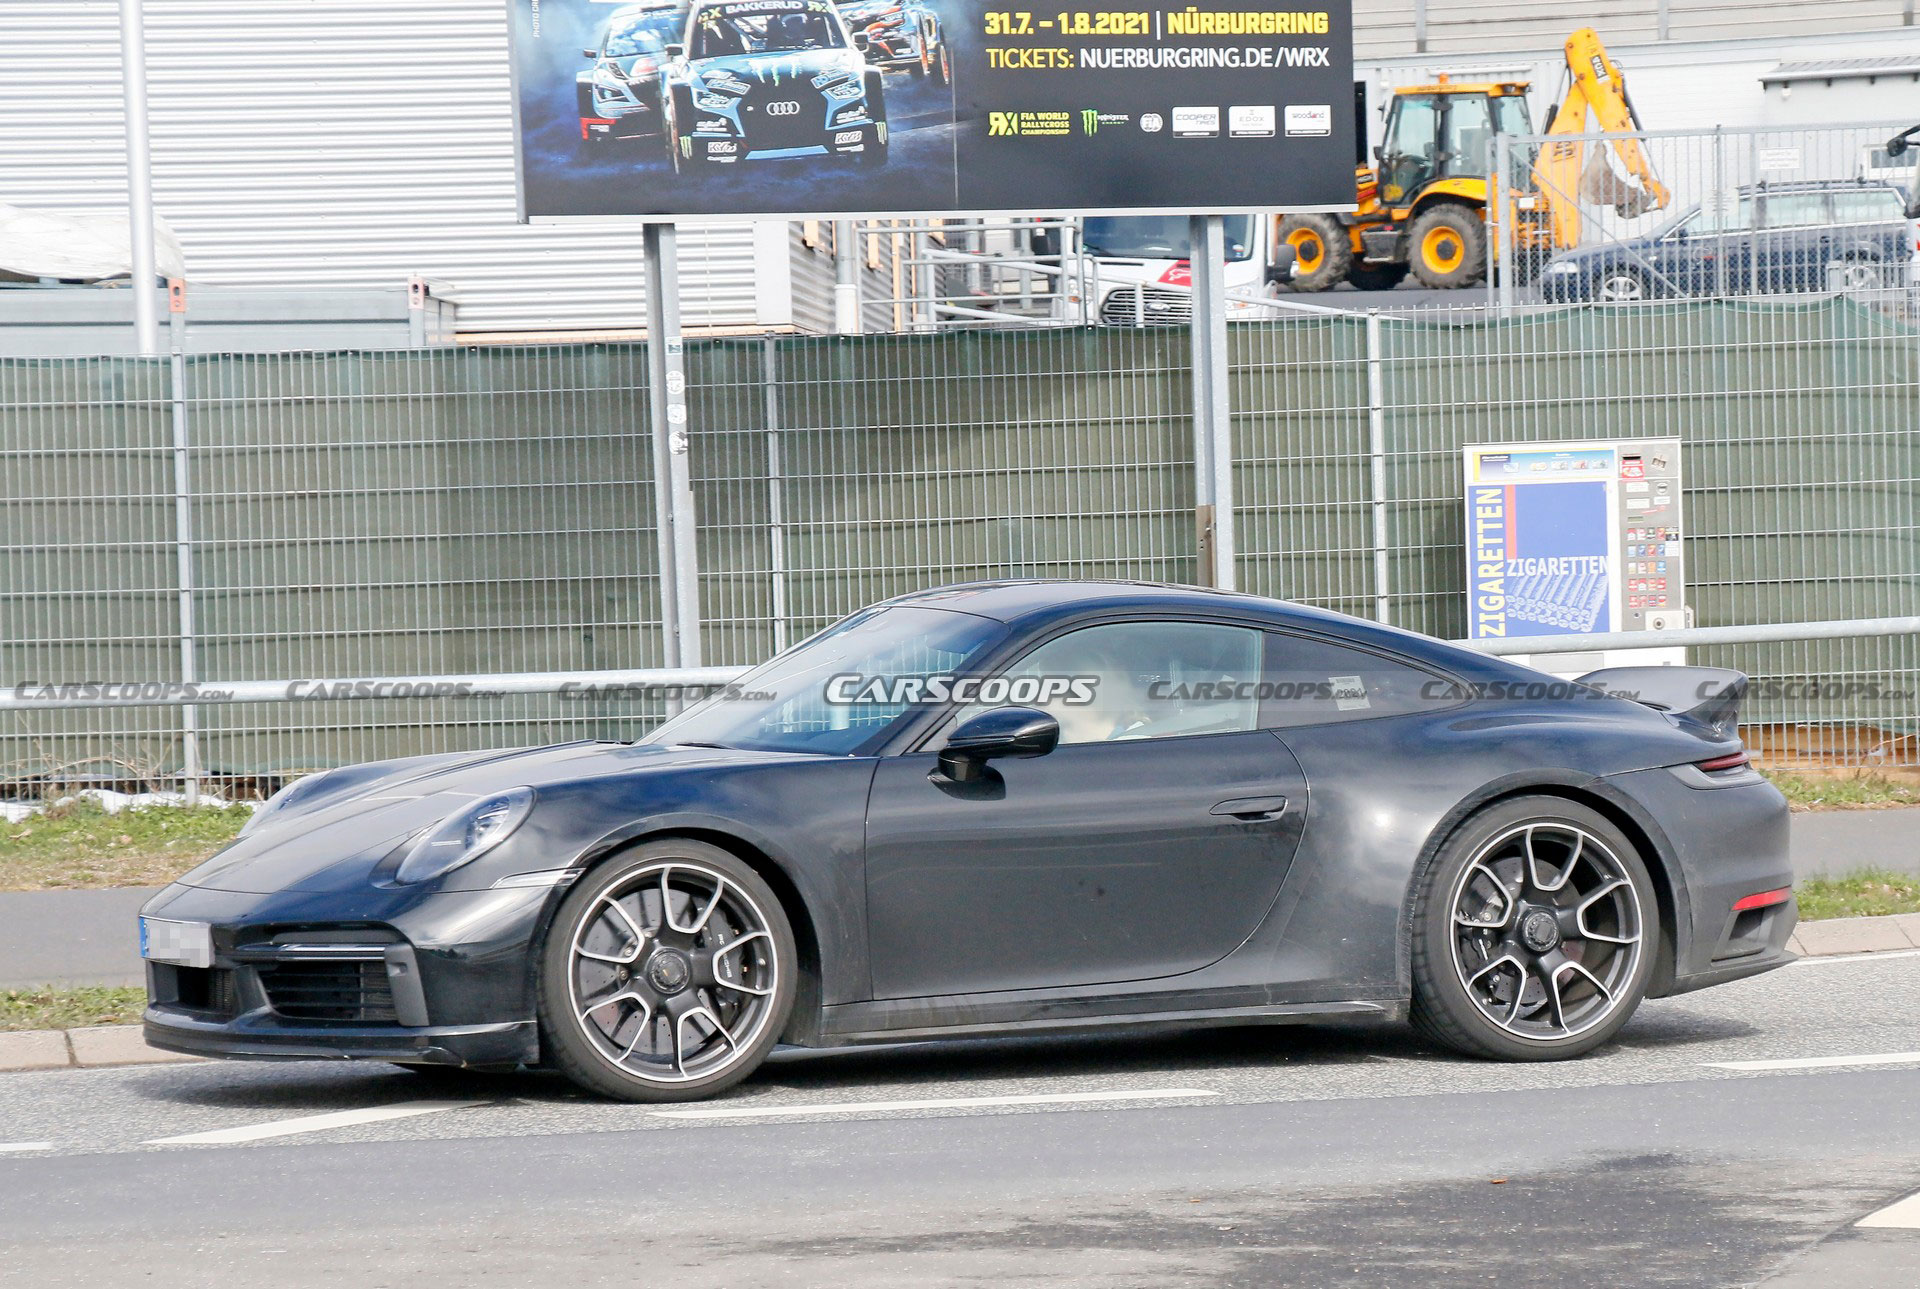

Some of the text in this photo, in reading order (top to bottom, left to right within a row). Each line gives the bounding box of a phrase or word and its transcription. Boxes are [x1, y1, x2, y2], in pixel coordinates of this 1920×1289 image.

[725, 1, 804, 14] BAKKERUD
[984, 12, 1035, 35] 31.7.
[1058, 12, 1150, 35] 1.8.2021
[1167, 6, 1329, 35] NÜRBURGRING
[985, 46, 1331, 69] TICKETS: NUERBURGRING.DE/WRX
[1020, 112, 1070, 121] FIA WORLD
[1175, 113, 1217, 121] COOPER
[1020, 120, 1070, 128] RALLYCROSS
[1020, 128, 1070, 136] CHAMPIONSHIP
[1475, 487, 1506, 638] ZIGARETTEN
[1506, 555, 1609, 578] ZIGARETTEN
